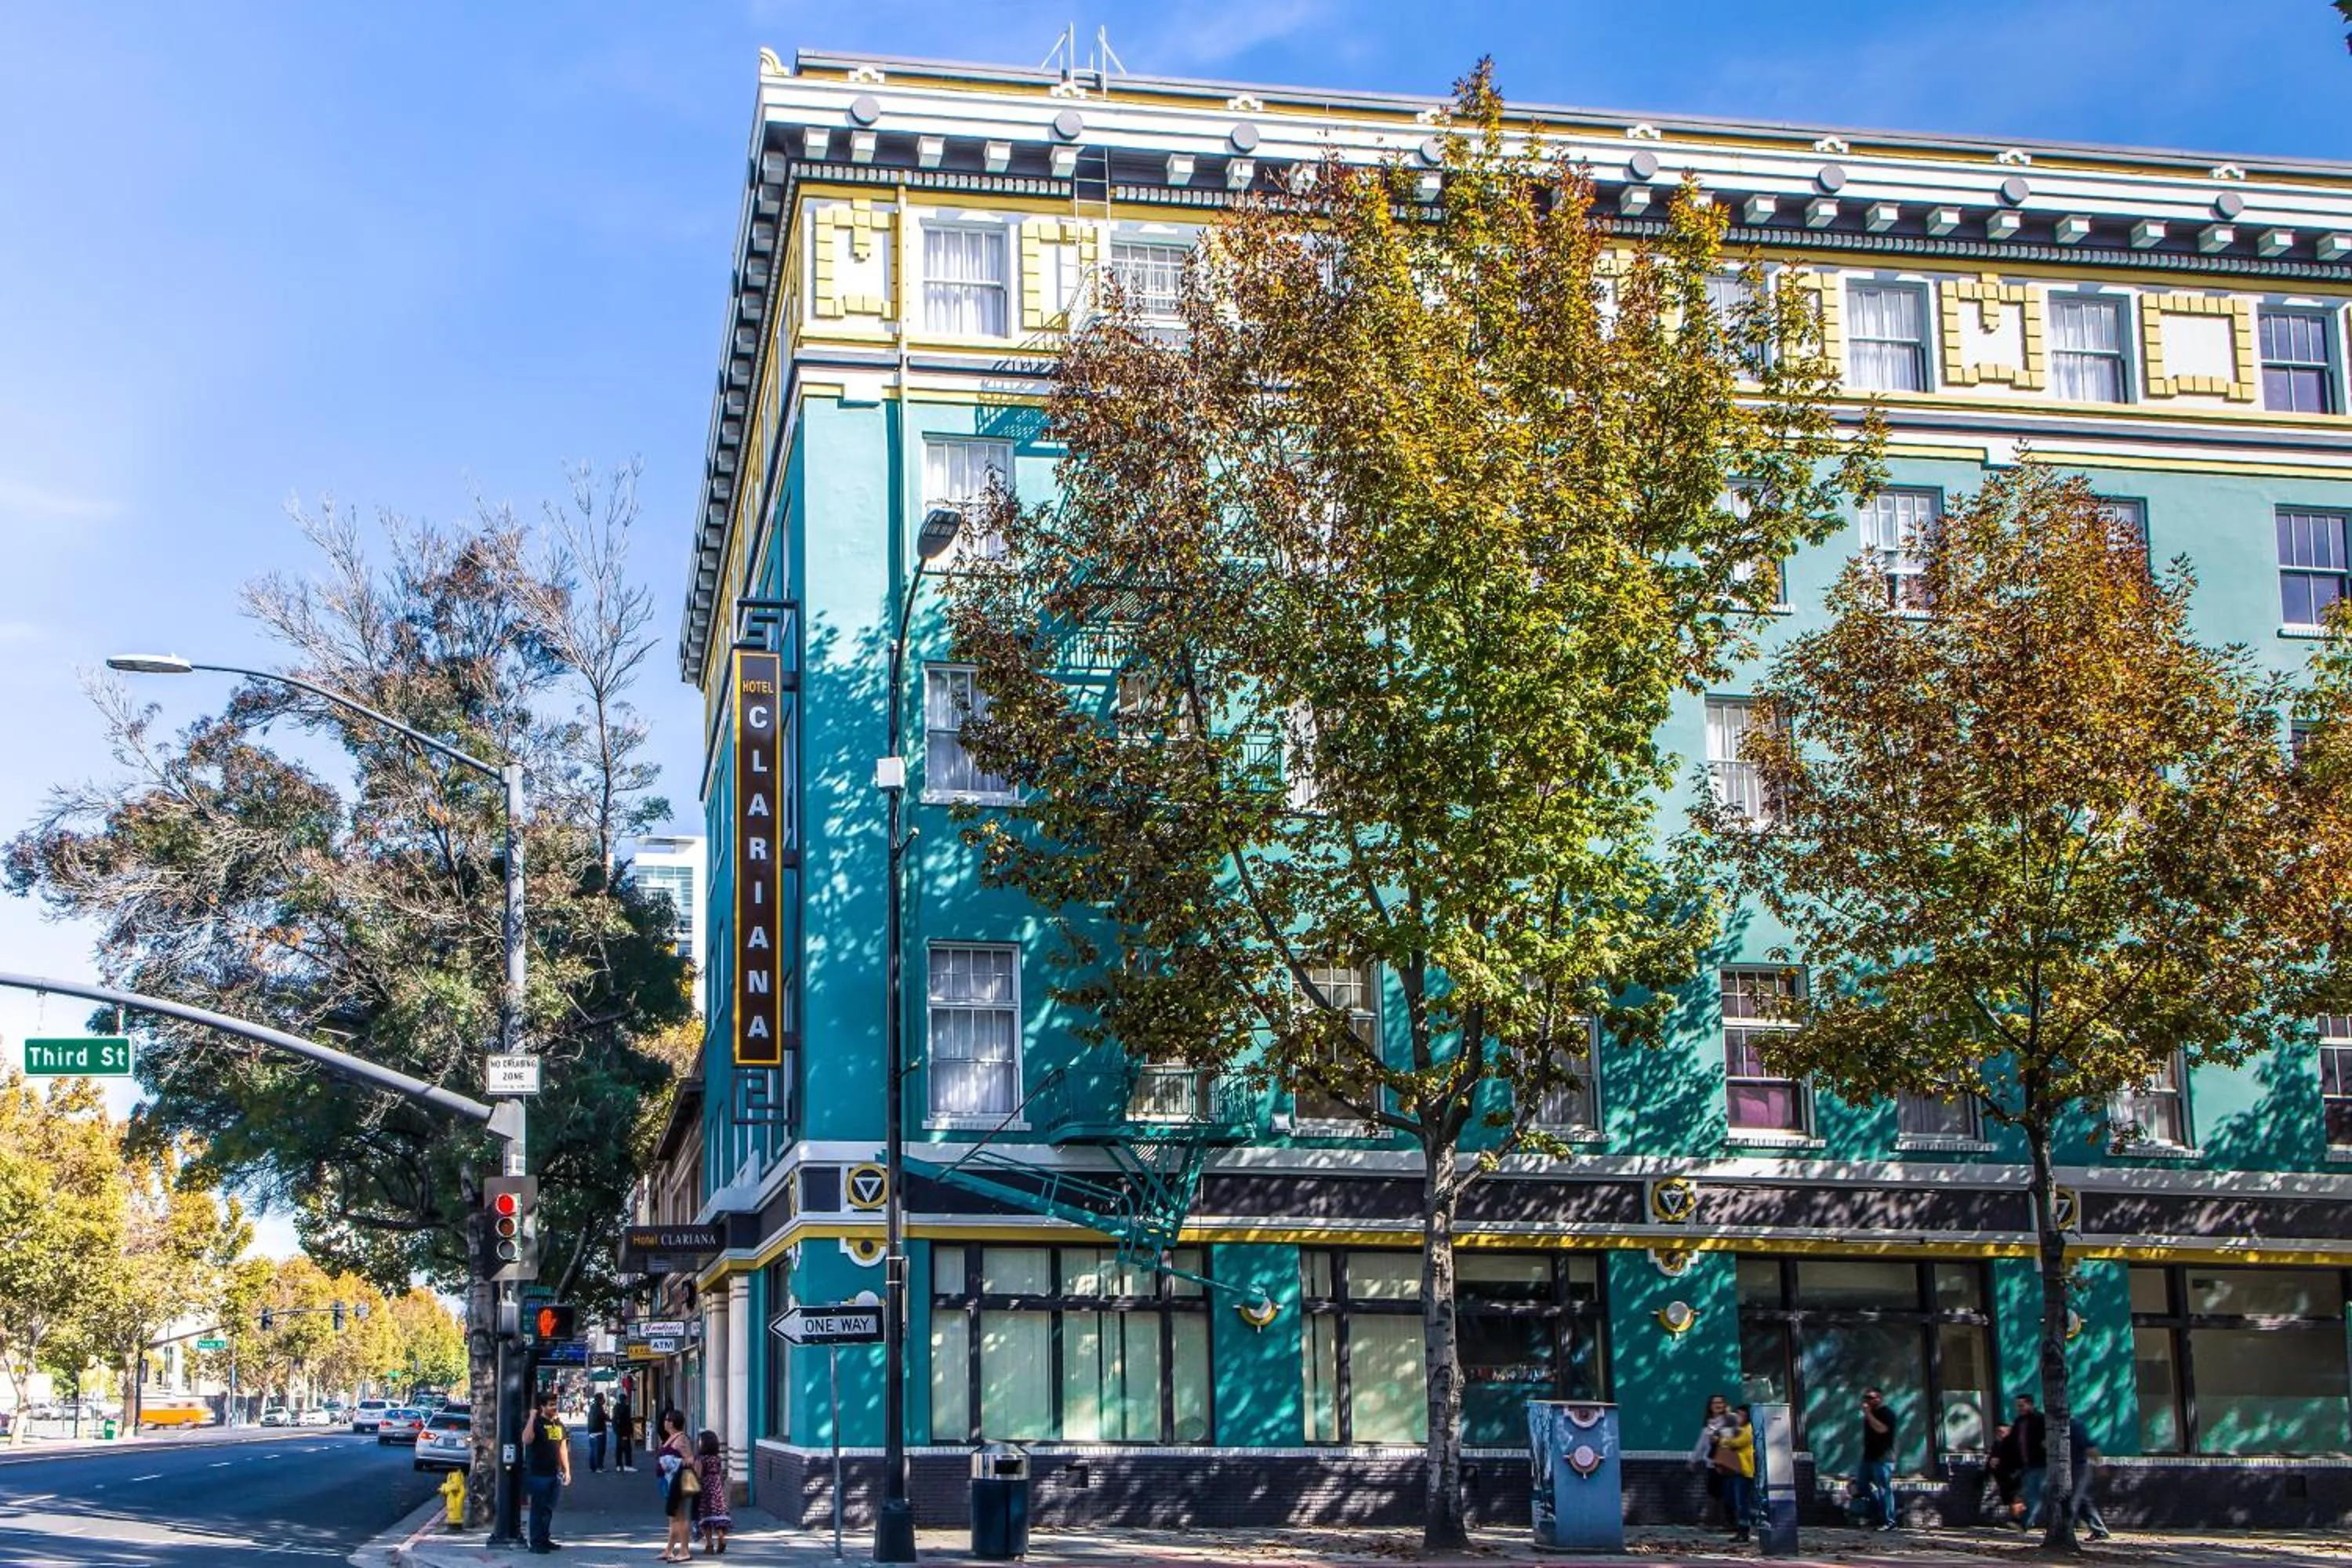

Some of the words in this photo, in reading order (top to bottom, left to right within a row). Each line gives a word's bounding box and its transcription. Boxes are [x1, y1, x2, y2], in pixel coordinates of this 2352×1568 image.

[742, 680, 774, 694] HOTEL
[747, 706, 769, 1038] CLARIANA
[29, 1046, 88, 1066] Third
[100, 1046, 125, 1066] St
[490, 1059, 501, 1069] NO
[503, 1072, 524, 1081] ZONE
[660, 1233, 716, 1246] CLARIANA
[805, 1319, 834, 1333] ONE
[840, 1318, 869, 1332] WAY
